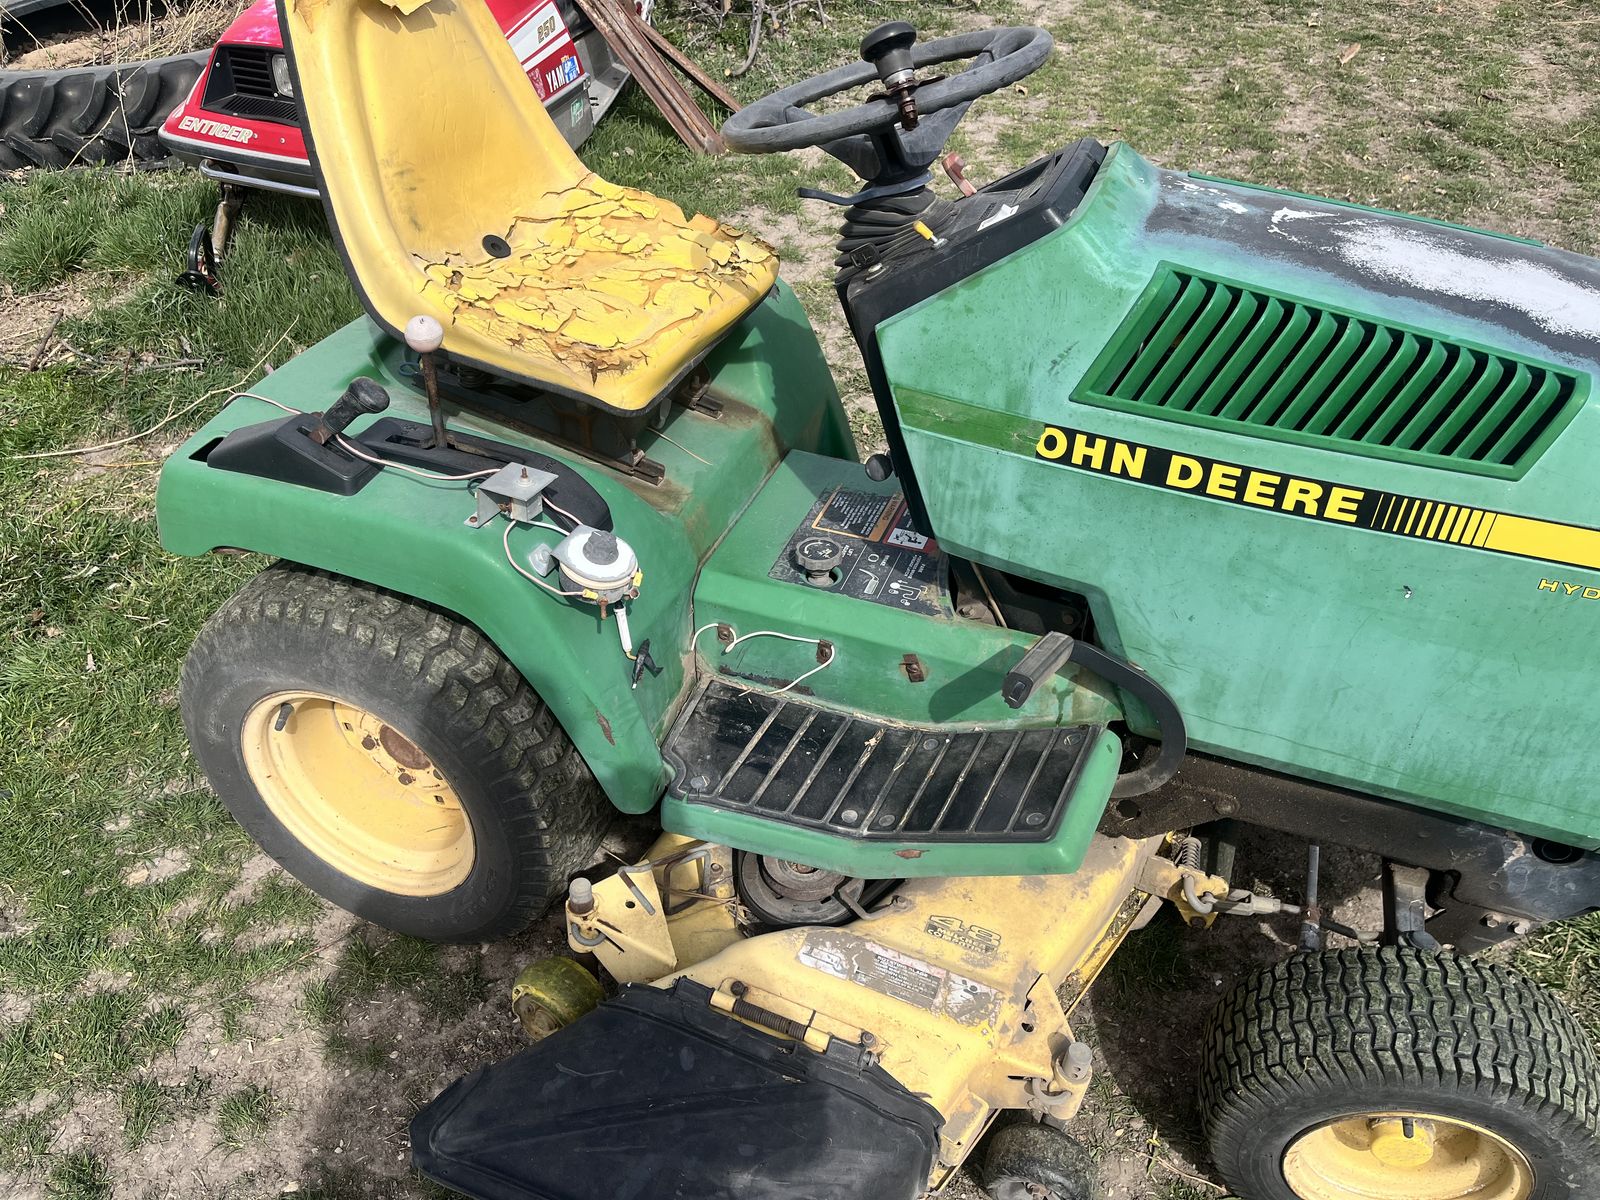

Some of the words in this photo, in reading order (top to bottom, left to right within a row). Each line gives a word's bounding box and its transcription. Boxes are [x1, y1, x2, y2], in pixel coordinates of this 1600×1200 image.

[537, 15, 556, 43] 250
[178, 115, 254, 144] ENTICER
[1165, 454, 1365, 523] DEERE
[1537, 578, 1600, 600] HYD
